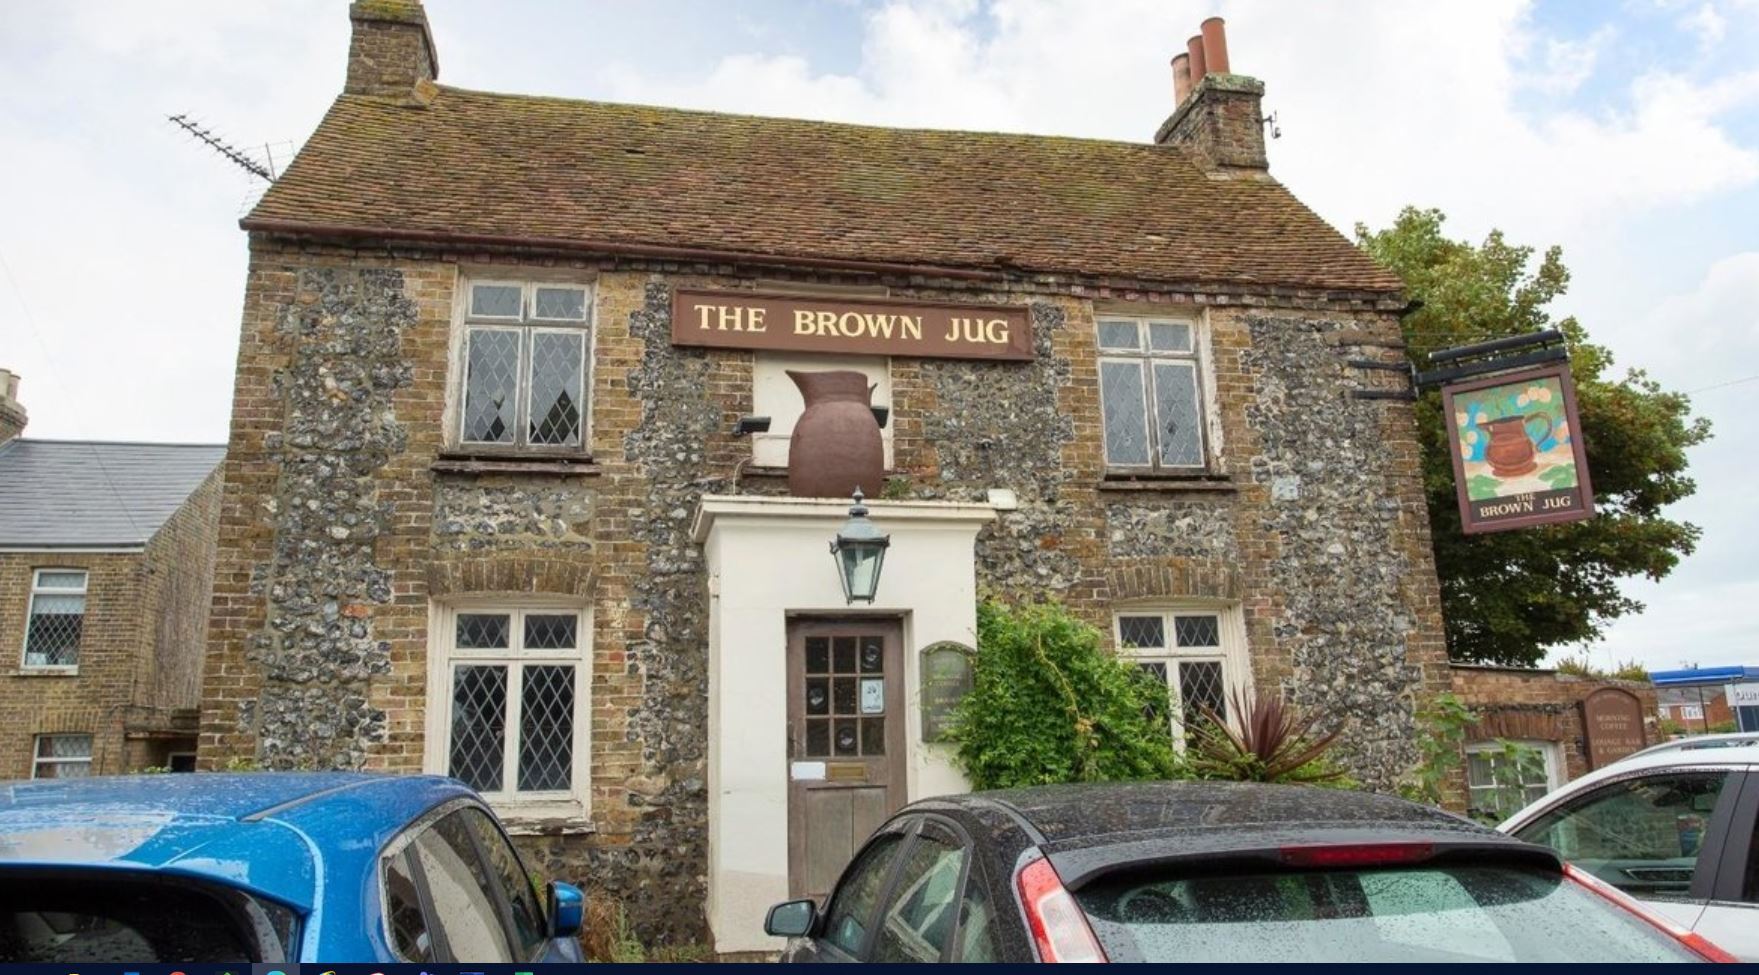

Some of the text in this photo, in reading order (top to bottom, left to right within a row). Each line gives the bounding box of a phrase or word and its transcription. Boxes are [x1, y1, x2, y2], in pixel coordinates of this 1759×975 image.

[694, 304, 1009, 343] THE BROWN JUG
[1480, 496, 1571, 517] BROWN JUG
[1514, 494, 1536, 502] THE
